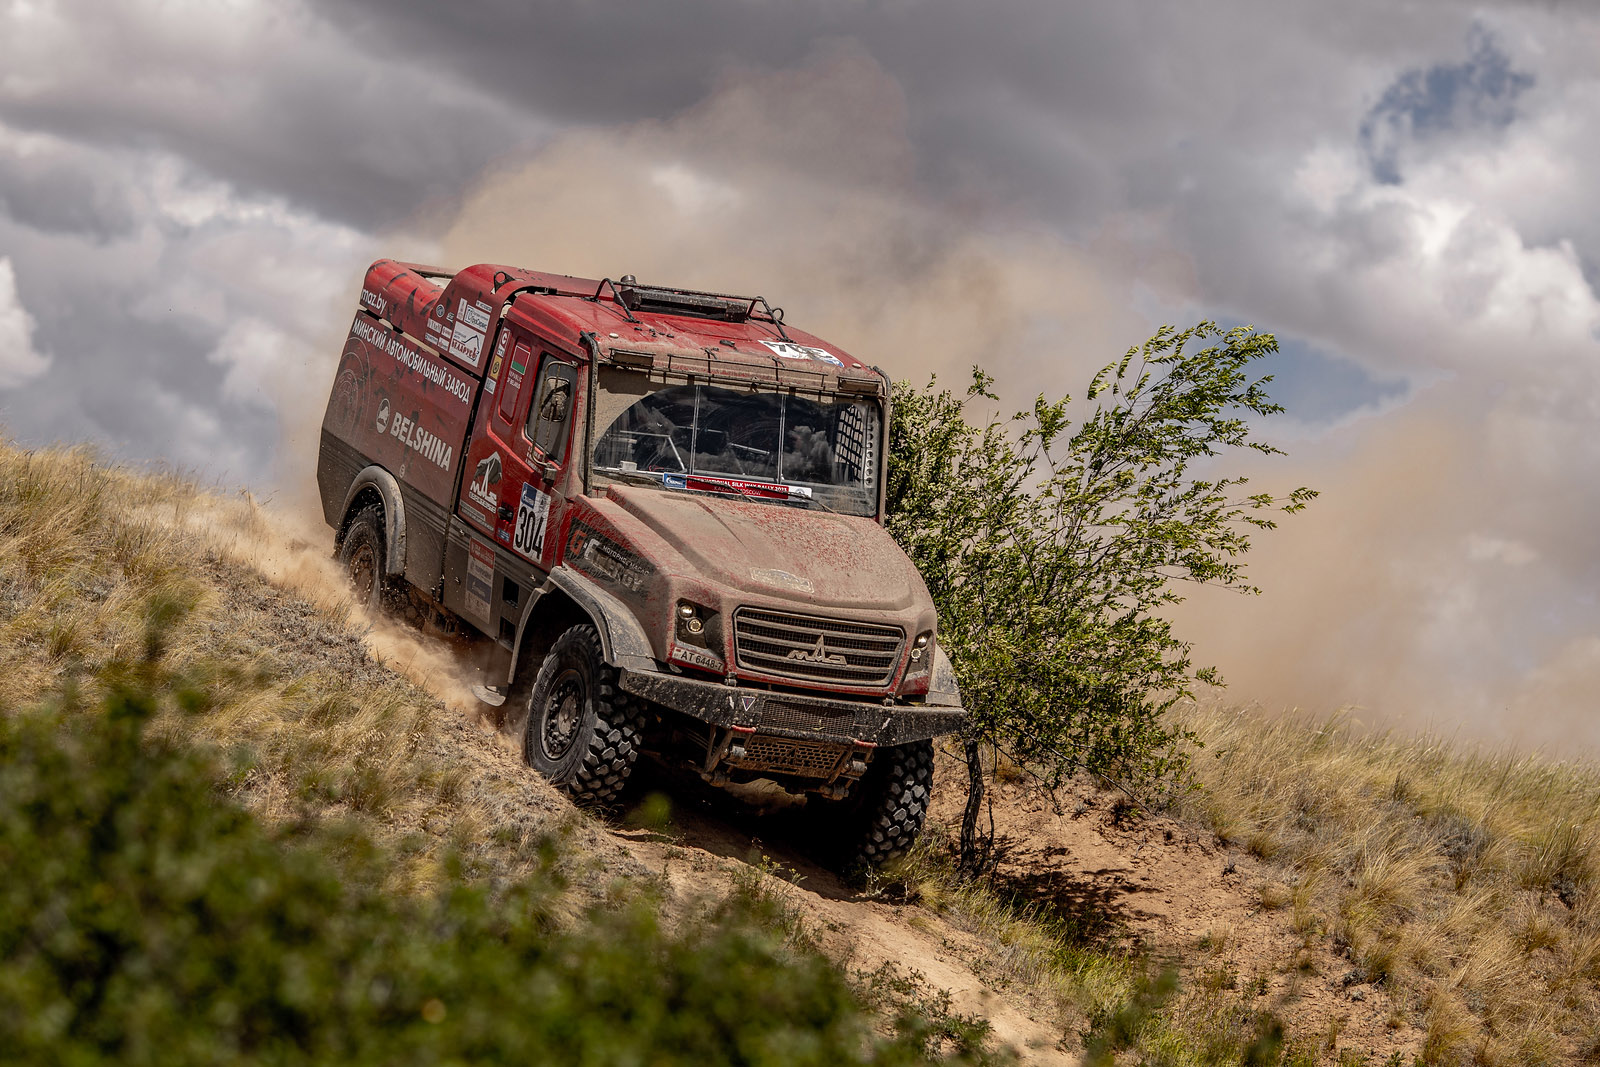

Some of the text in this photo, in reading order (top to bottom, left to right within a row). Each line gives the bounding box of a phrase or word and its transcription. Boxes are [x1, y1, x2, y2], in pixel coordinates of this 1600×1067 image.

[361, 289, 387, 314] maz.by
[352, 318, 387, 351] МИНСКИЙ
[384, 339, 447, 387] АВТОМОБИЛЬНЫЙ
[445, 374, 471, 405] ЗАВОД
[390, 412, 453, 472] BELSHINA
[515, 506, 543, 559] 304
[680, 651, 723, 671] AT 6448-7
